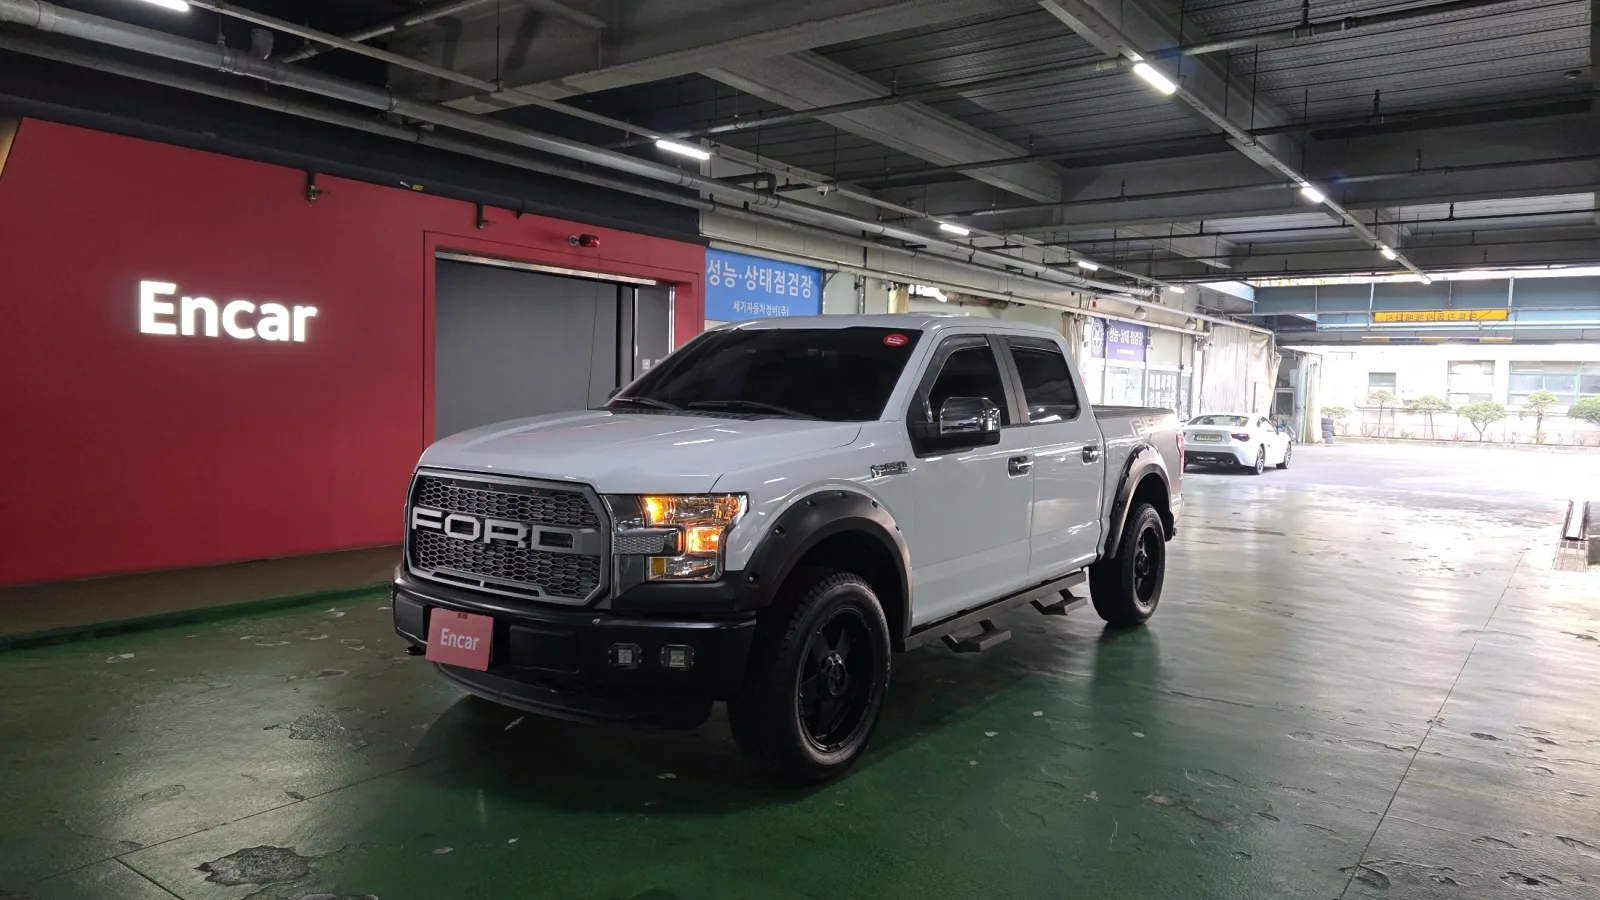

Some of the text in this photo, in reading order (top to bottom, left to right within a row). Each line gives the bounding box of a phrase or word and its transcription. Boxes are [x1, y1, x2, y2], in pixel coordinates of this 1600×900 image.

[140, 280, 318, 342] Encar
[412, 506, 583, 553] FORD
[440, 627, 480, 651] Encar
